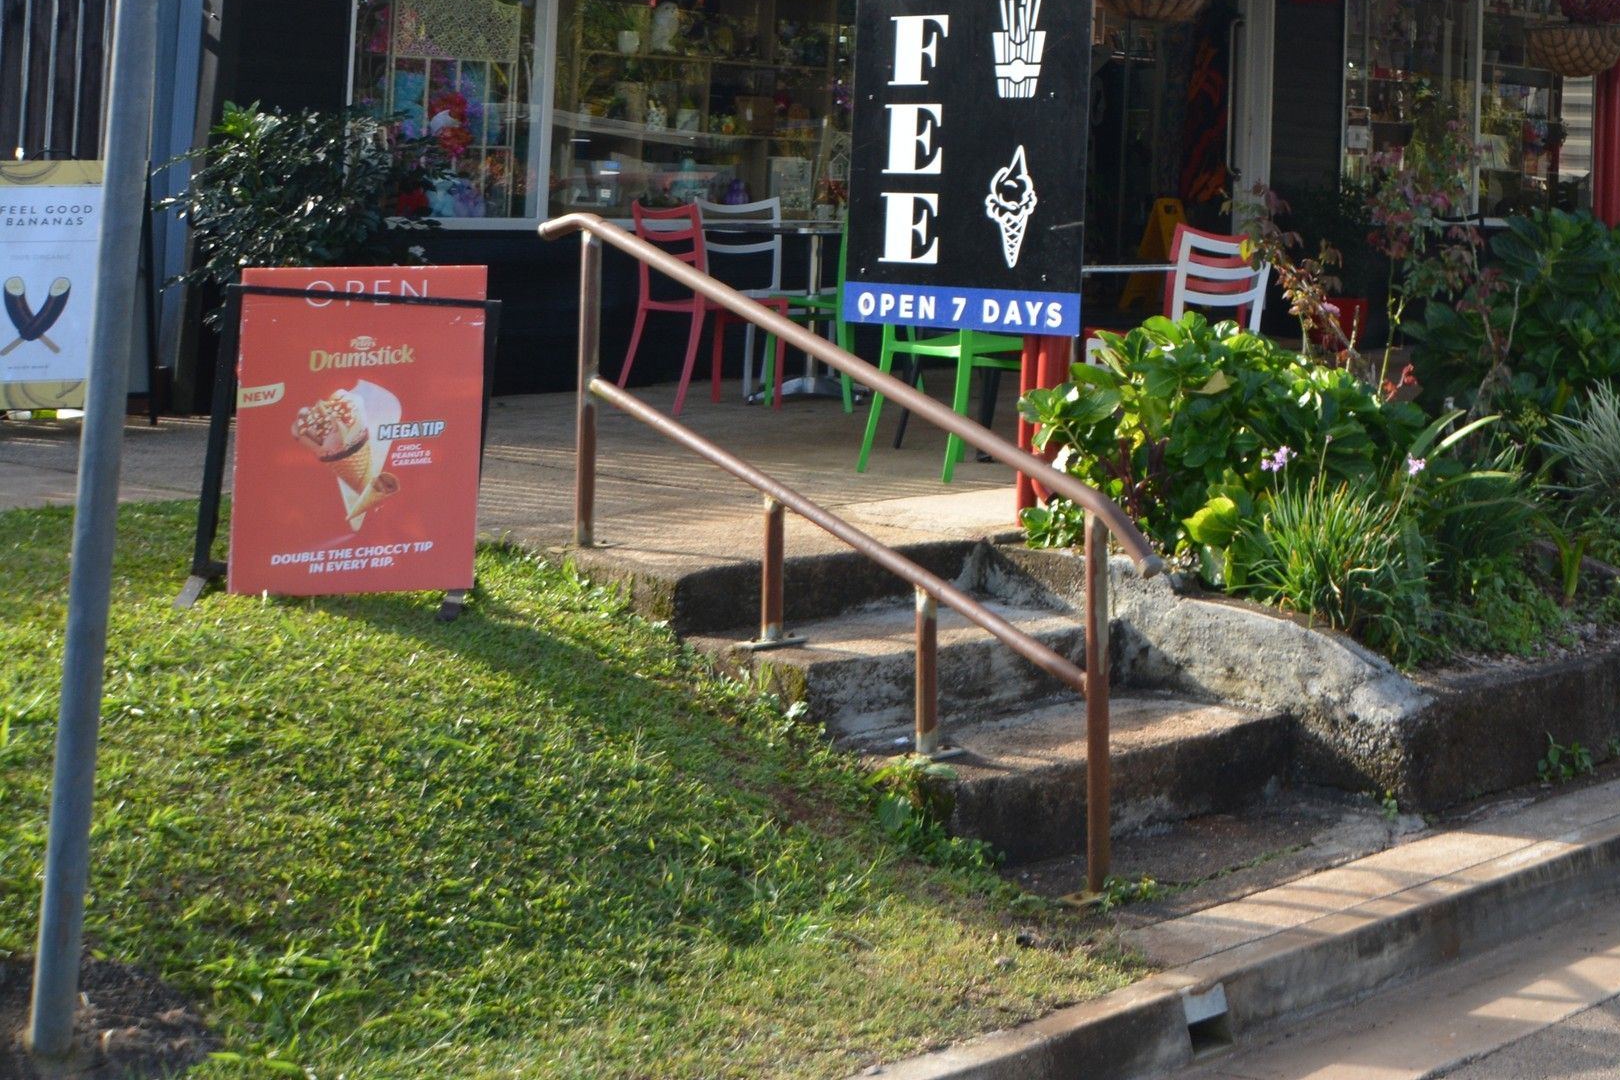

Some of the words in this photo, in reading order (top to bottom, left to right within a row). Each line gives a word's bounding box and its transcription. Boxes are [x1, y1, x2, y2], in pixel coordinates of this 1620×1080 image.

[0, 205, 37, 215] FEEL
[45, 205, 94, 215] GOOD
[5, 216, 84, 227] BANANAS
[305, 279, 428, 308] OPEN
[857, 291, 937, 322] OPEN
[952, 297, 968, 322] 7
[983, 297, 1063, 328] DAYS
[309, 344, 415, 372] Drumstick
[243, 389, 277, 402] NEW
[377, 423, 420, 441] MEGA
[422, 420, 446, 437] TIP
[271, 551, 325, 566] DOUBLE
[328, 548, 353, 560] THE
[355, 543, 411, 558] CHOCCY
[413, 541, 434, 552] TIP
[309, 562, 324, 573] IN
[326, 558, 367, 572] EVERY
[370, 557, 395, 569] RIP.
